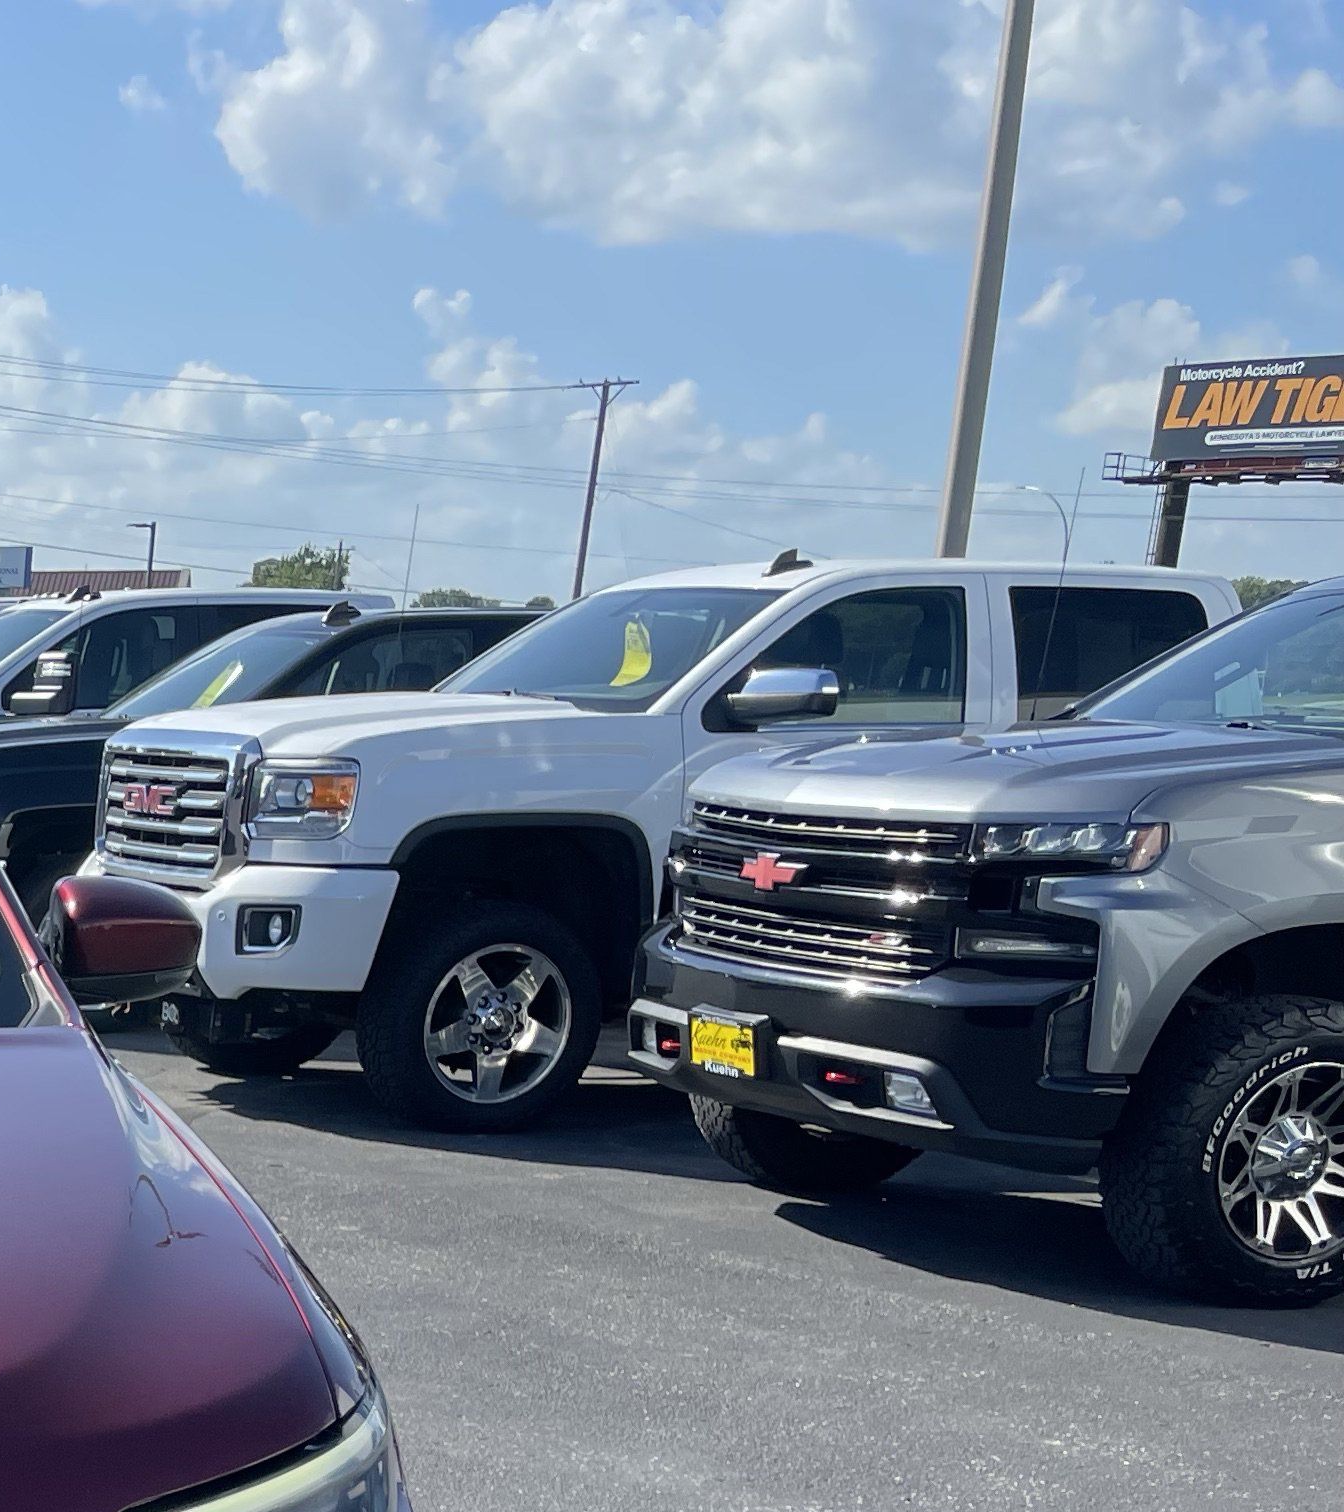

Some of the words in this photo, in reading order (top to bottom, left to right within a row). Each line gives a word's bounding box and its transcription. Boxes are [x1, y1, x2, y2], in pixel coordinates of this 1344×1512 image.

[1180, 366, 1242, 382] Motorcycle
[1243, 361, 1305, 377] Accident?
[1162, 379, 1270, 430] LAW
[123, 782, 177, 816] GMC
[704, 1060, 739, 1078] Kuehn
[1202, 1045, 1309, 1173] BFGoodrich
